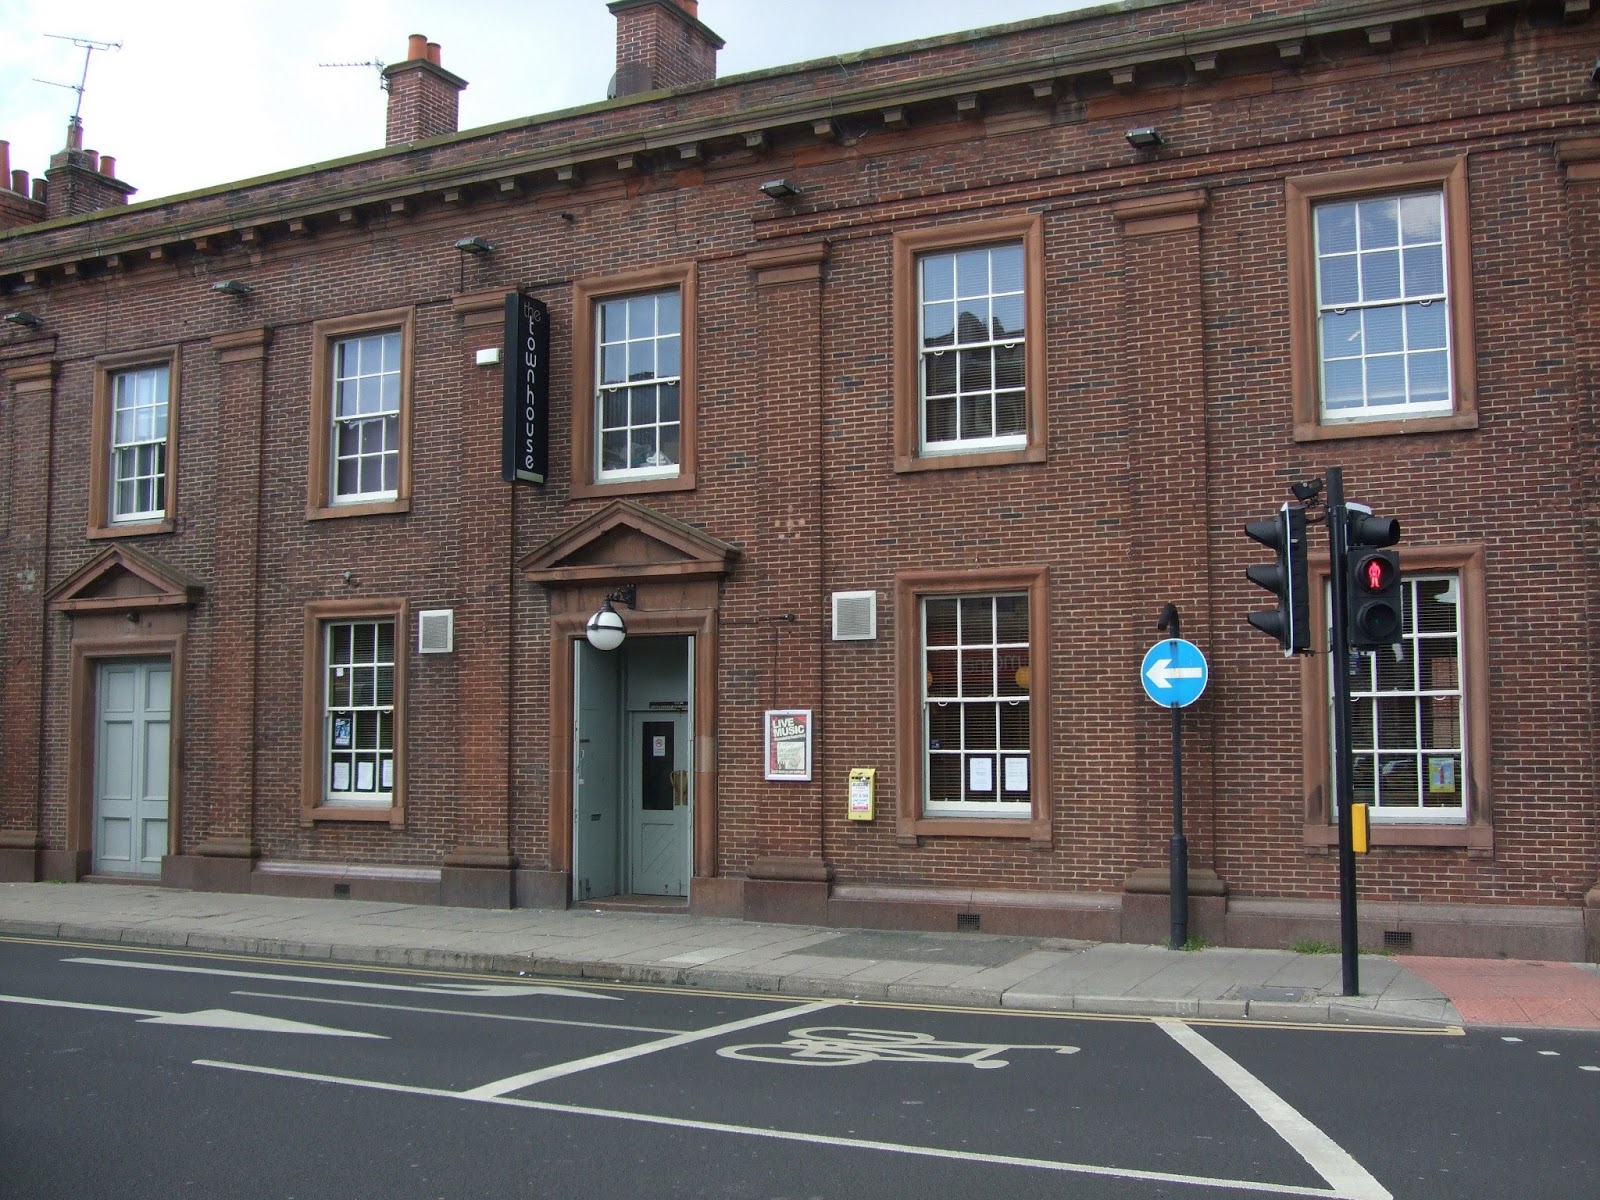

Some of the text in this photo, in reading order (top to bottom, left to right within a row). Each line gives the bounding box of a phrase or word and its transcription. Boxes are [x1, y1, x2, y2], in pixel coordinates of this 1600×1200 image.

[524, 301, 541, 322] the
[526, 315, 537, 469] townhouse
[772, 718, 794, 728] LIVE
[773, 725, 804, 737] MUSIC
